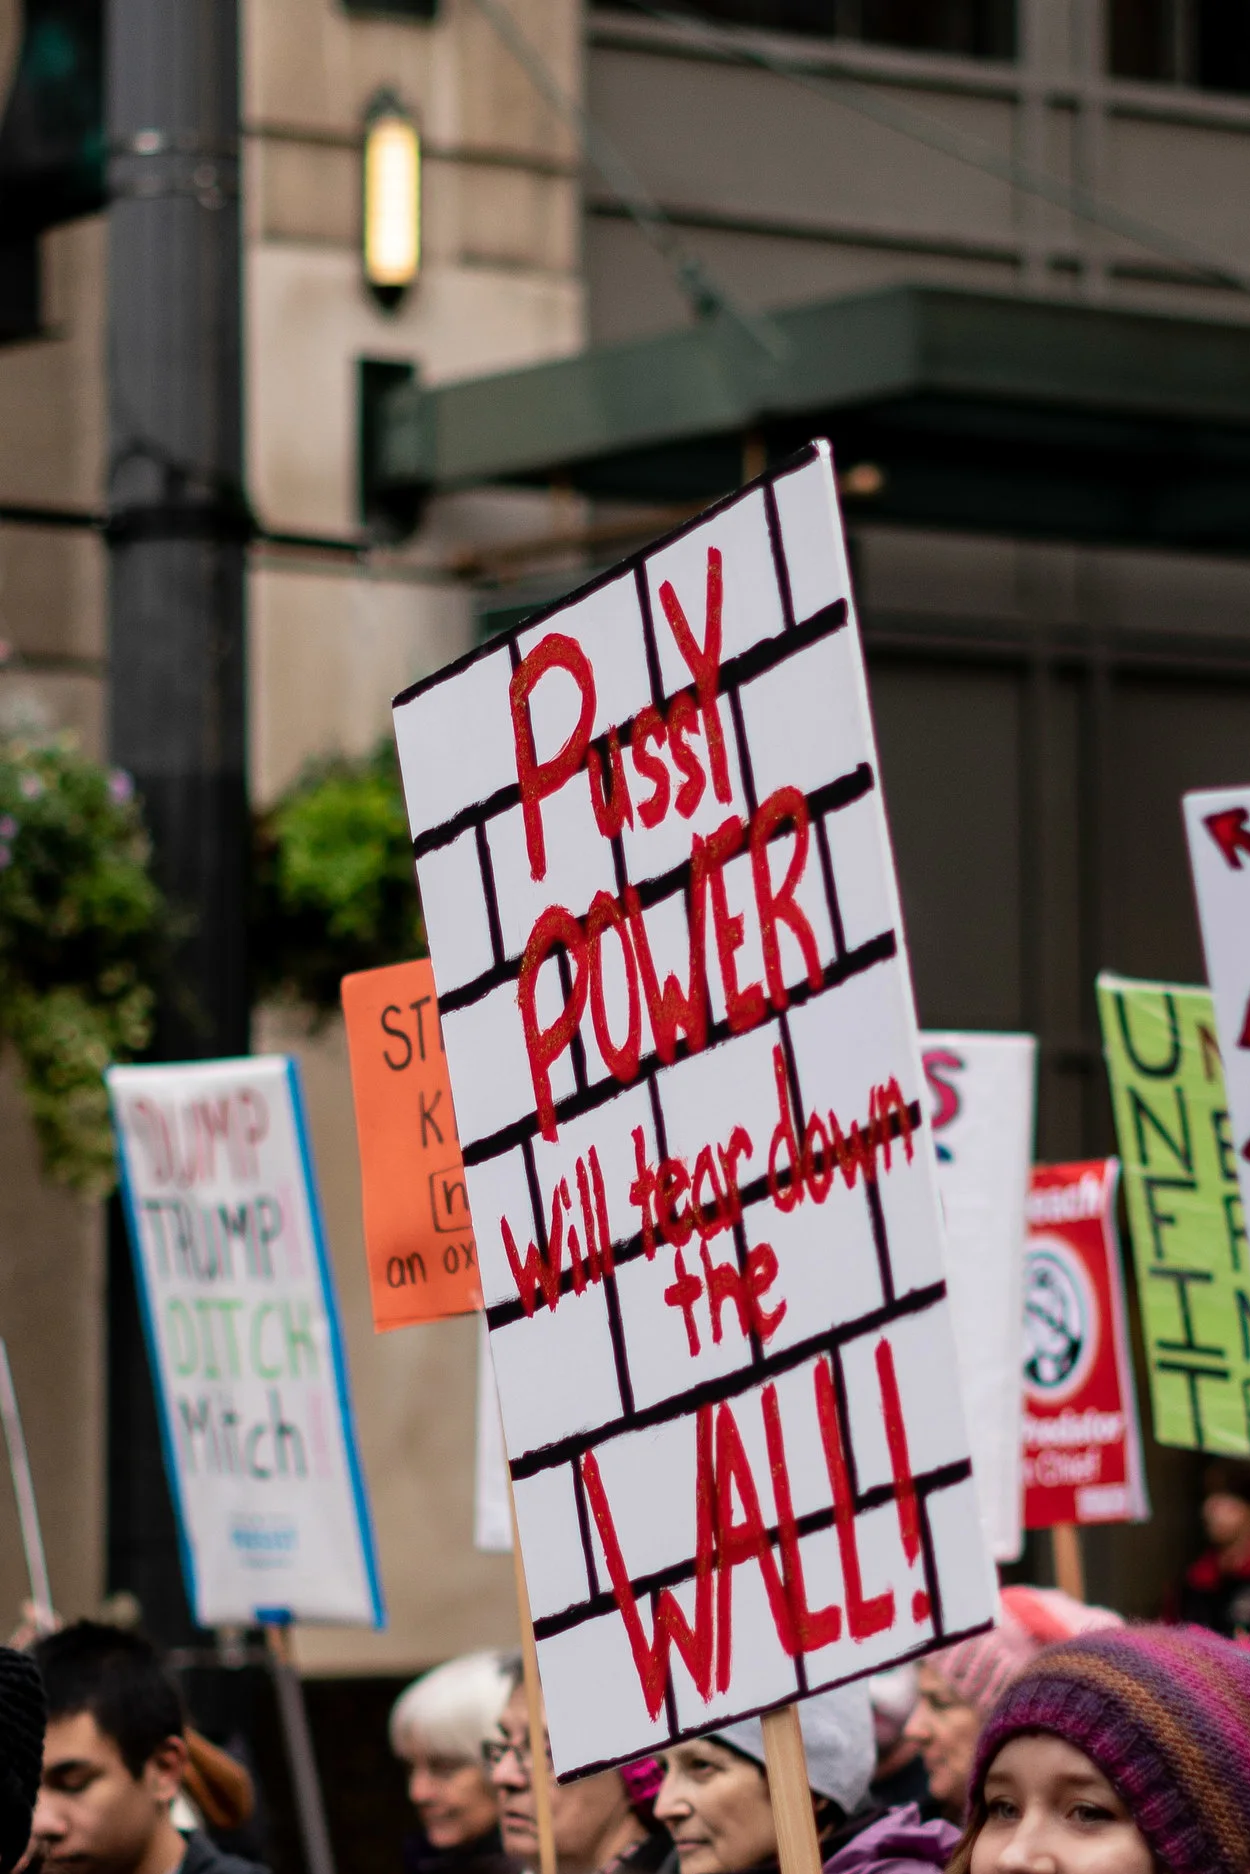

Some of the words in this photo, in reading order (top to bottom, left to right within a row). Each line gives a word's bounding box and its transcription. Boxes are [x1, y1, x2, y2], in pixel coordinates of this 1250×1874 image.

[516, 786, 822, 1143] POWER
[127, 1087, 270, 1188] DUMP
[628, 1124, 753, 1261] tear
[767, 1043, 914, 1214] down
[166, 1298, 320, 1381] DITCH
[664, 1238, 787, 1357] the
[580, 1336, 932, 1723] WALL!
